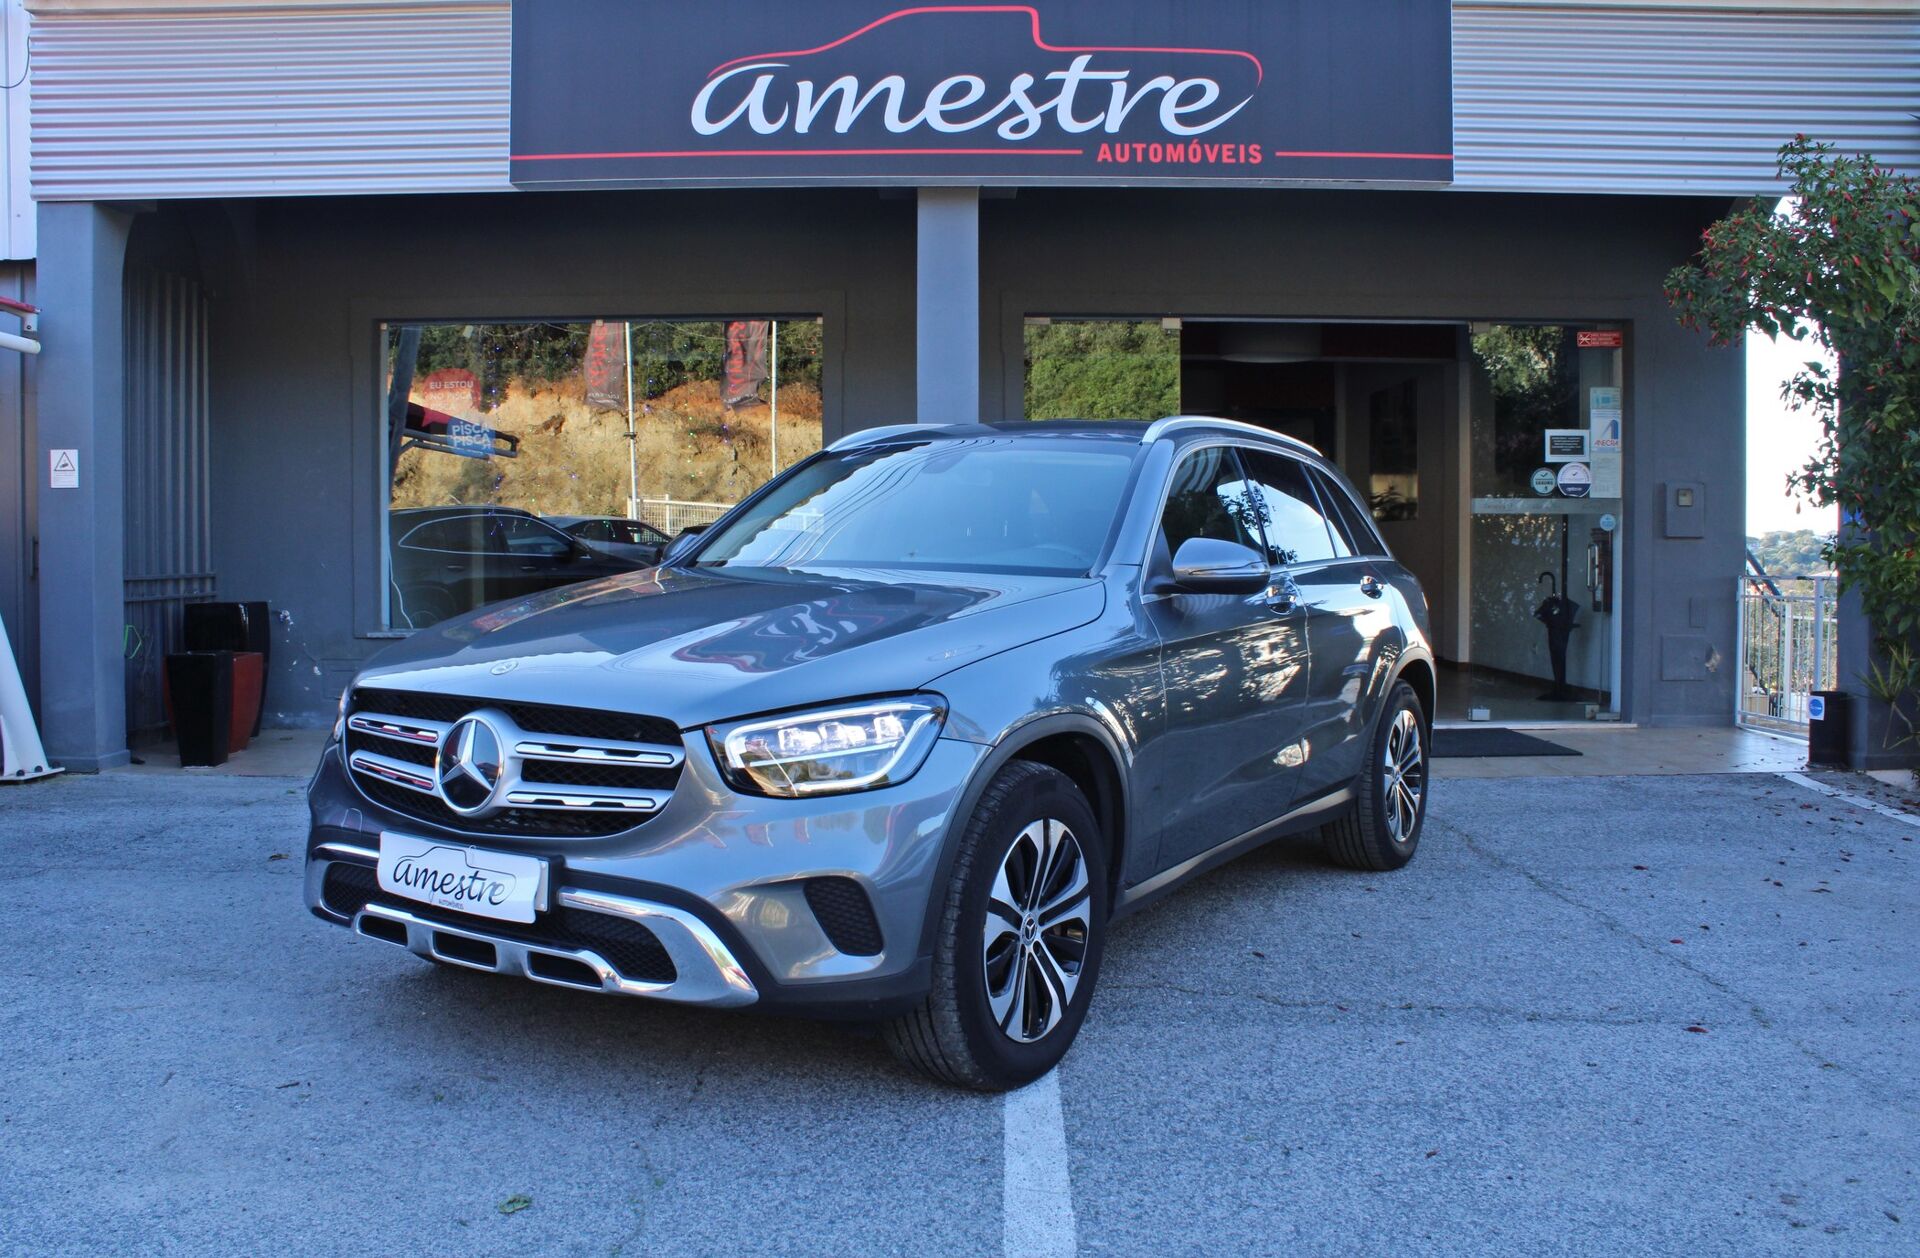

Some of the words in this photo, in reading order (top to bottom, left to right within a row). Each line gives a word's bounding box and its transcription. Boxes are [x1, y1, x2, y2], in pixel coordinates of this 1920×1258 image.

[691, 54, 1254, 141] amestre
[1096, 139, 1263, 164] AUTOMÓVEIS
[444, 381, 474, 389] ESTOU
[393, 858, 507, 906] amestre
